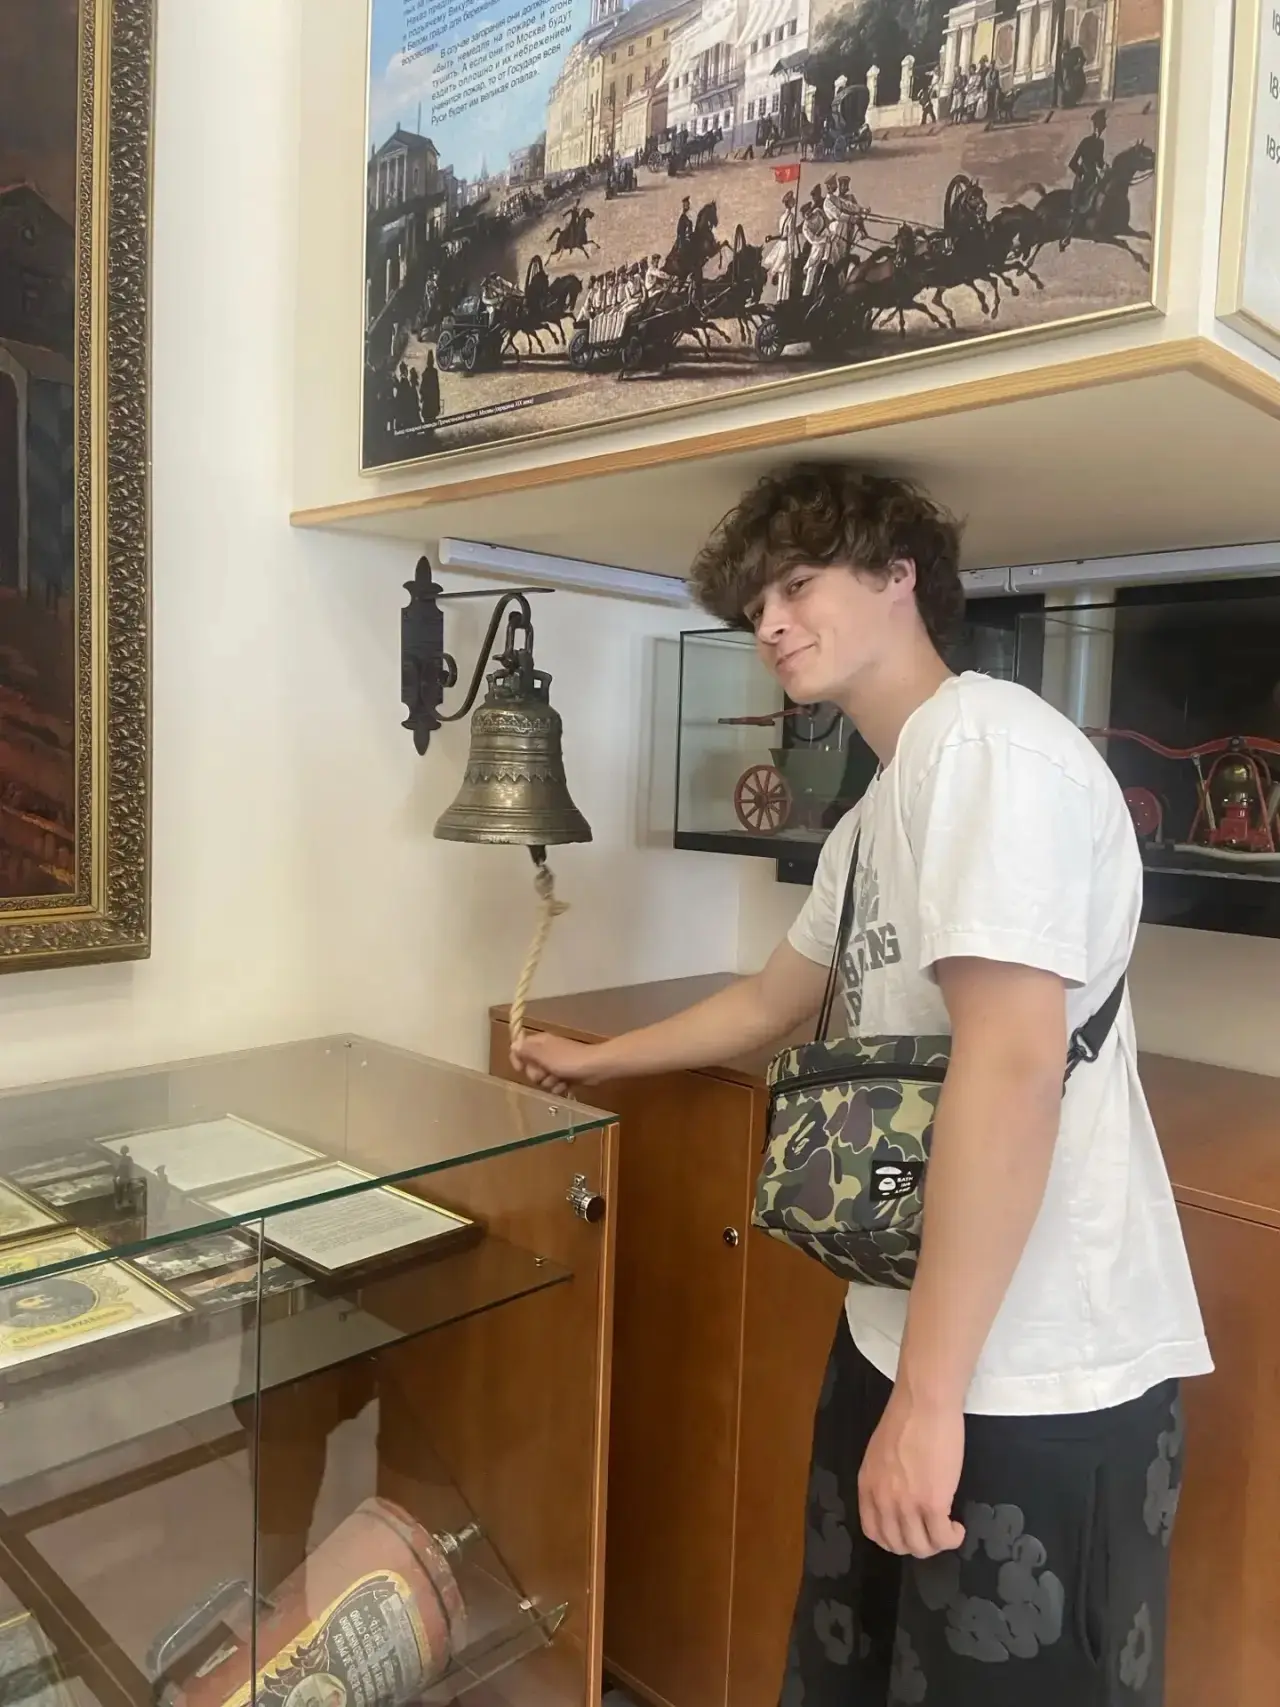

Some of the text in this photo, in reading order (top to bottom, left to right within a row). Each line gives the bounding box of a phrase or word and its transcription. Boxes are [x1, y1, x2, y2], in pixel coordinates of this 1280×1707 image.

[440, 50, 445, 58] В
[446, 38, 469, 56] случае
[471, 18, 505, 43] загорания
[506, 10, 520, 24] они
[457, 40, 490, 62] немедля
[493, 32, 502, 43] на
[507, 15, 535, 36] пожаре
[540, 10, 544, 20] и
[462, 62, 467, 72] А
[469, 54, 486, 68] если
[488, 45, 503, 59] они
[505, 39, 514, 50] по
[516, 23, 545, 44] Москве
[548, 9, 572, 28] будут
[502, 55, 510, 65] их
[513, 23, 571, 58] небрежением
[488, 75, 496, 85] то
[497, 70, 505, 81] от
[507, 53, 541, 76] Государя
[543, 42, 560, 59] всея
[448, 103, 467, 118] будет
[469, 98, 478, 109] им
[480, 84, 509, 102] великая
